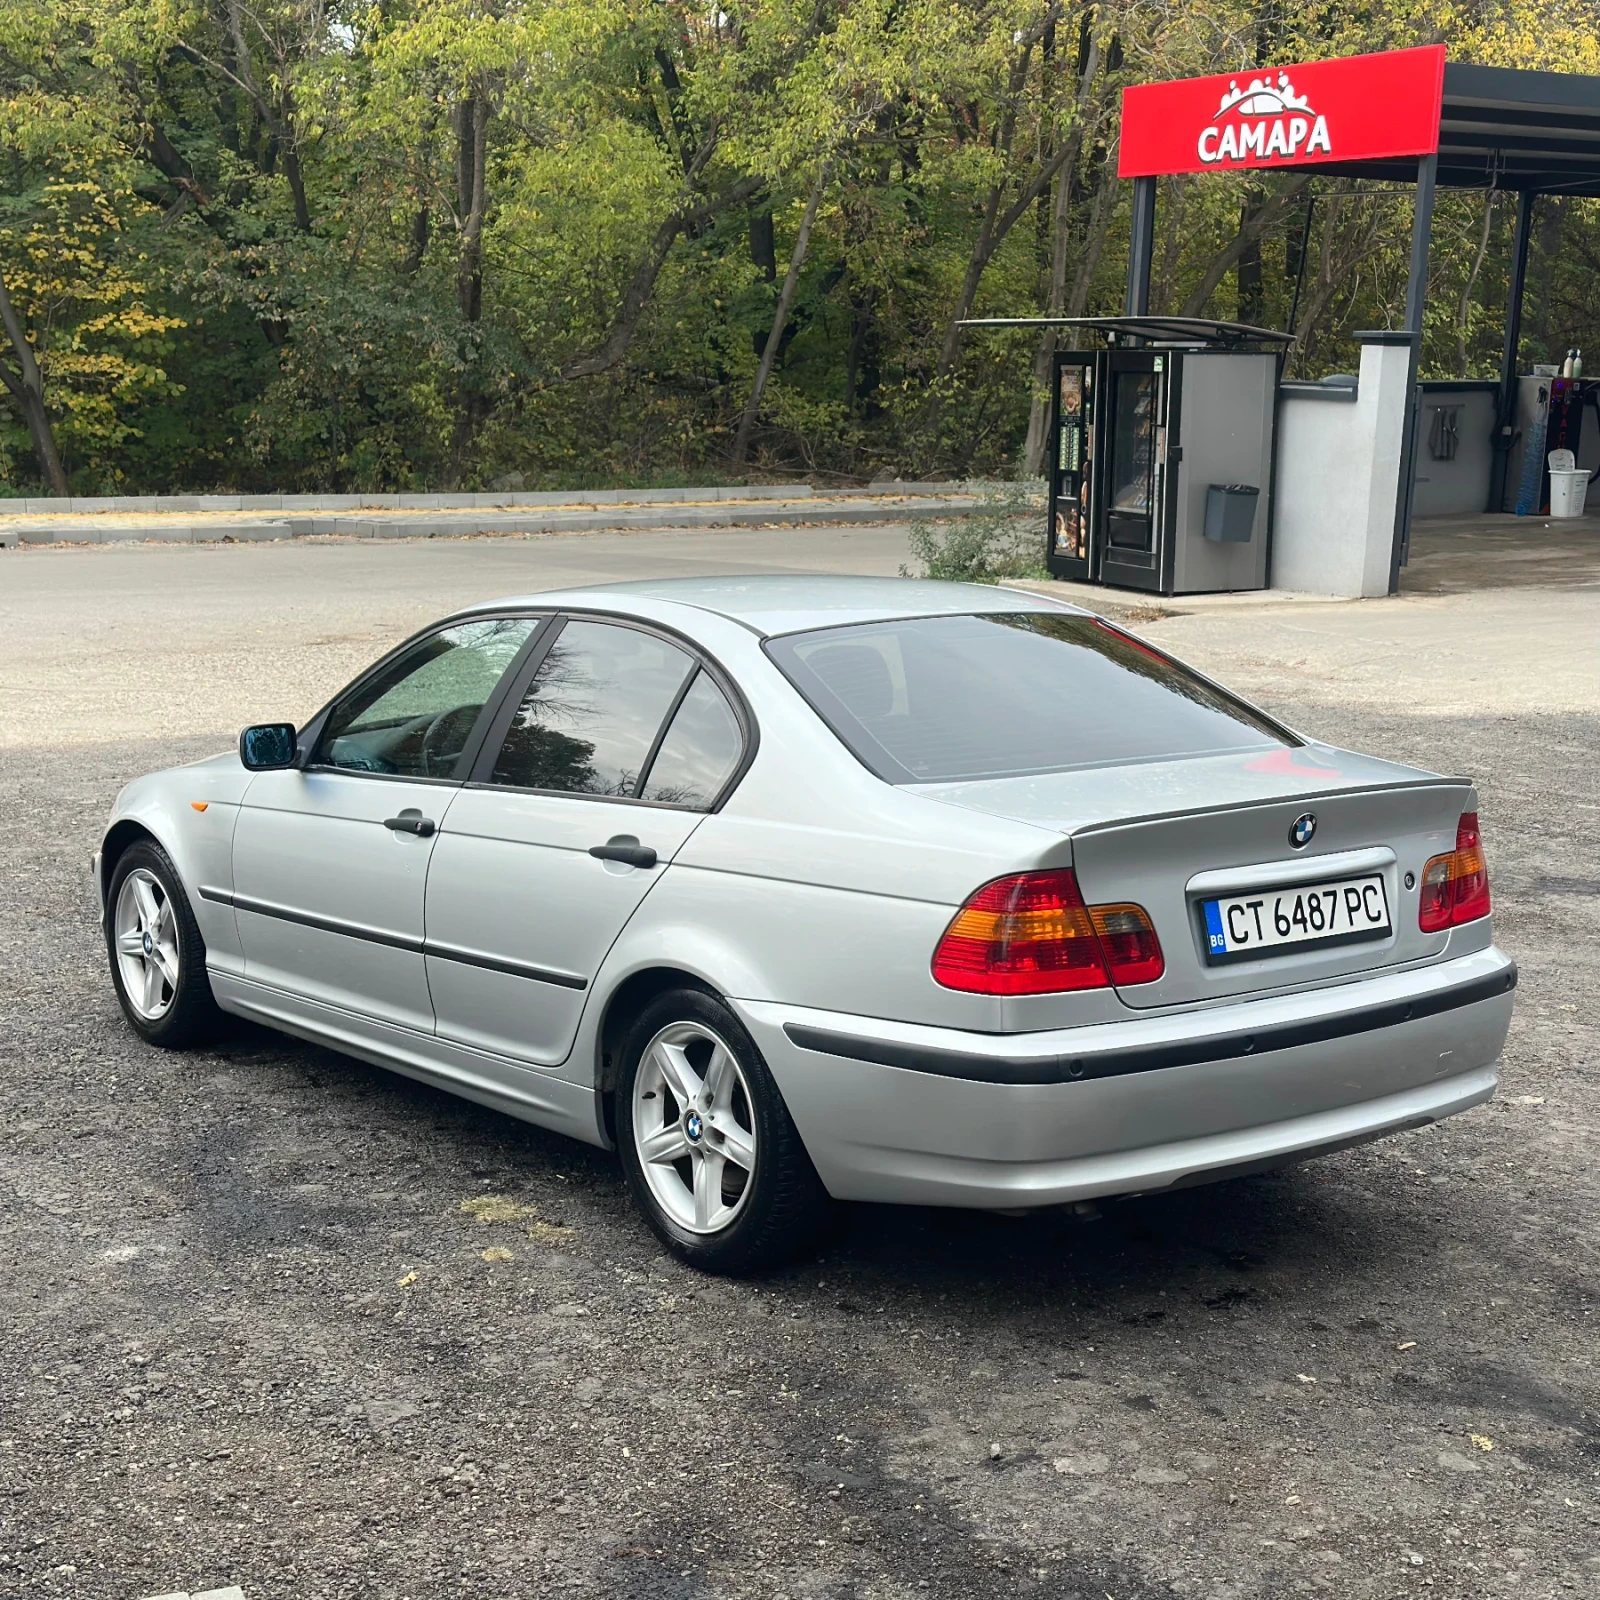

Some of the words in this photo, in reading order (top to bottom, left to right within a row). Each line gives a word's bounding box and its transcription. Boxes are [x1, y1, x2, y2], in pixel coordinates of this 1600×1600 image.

[1198, 115, 1331, 164] САМАРА
[1227, 900, 1264, 944] CT
[1274, 889, 1338, 937] 6487
[1343, 884, 1382, 926] PC
[1210, 933, 1224, 948] BG
